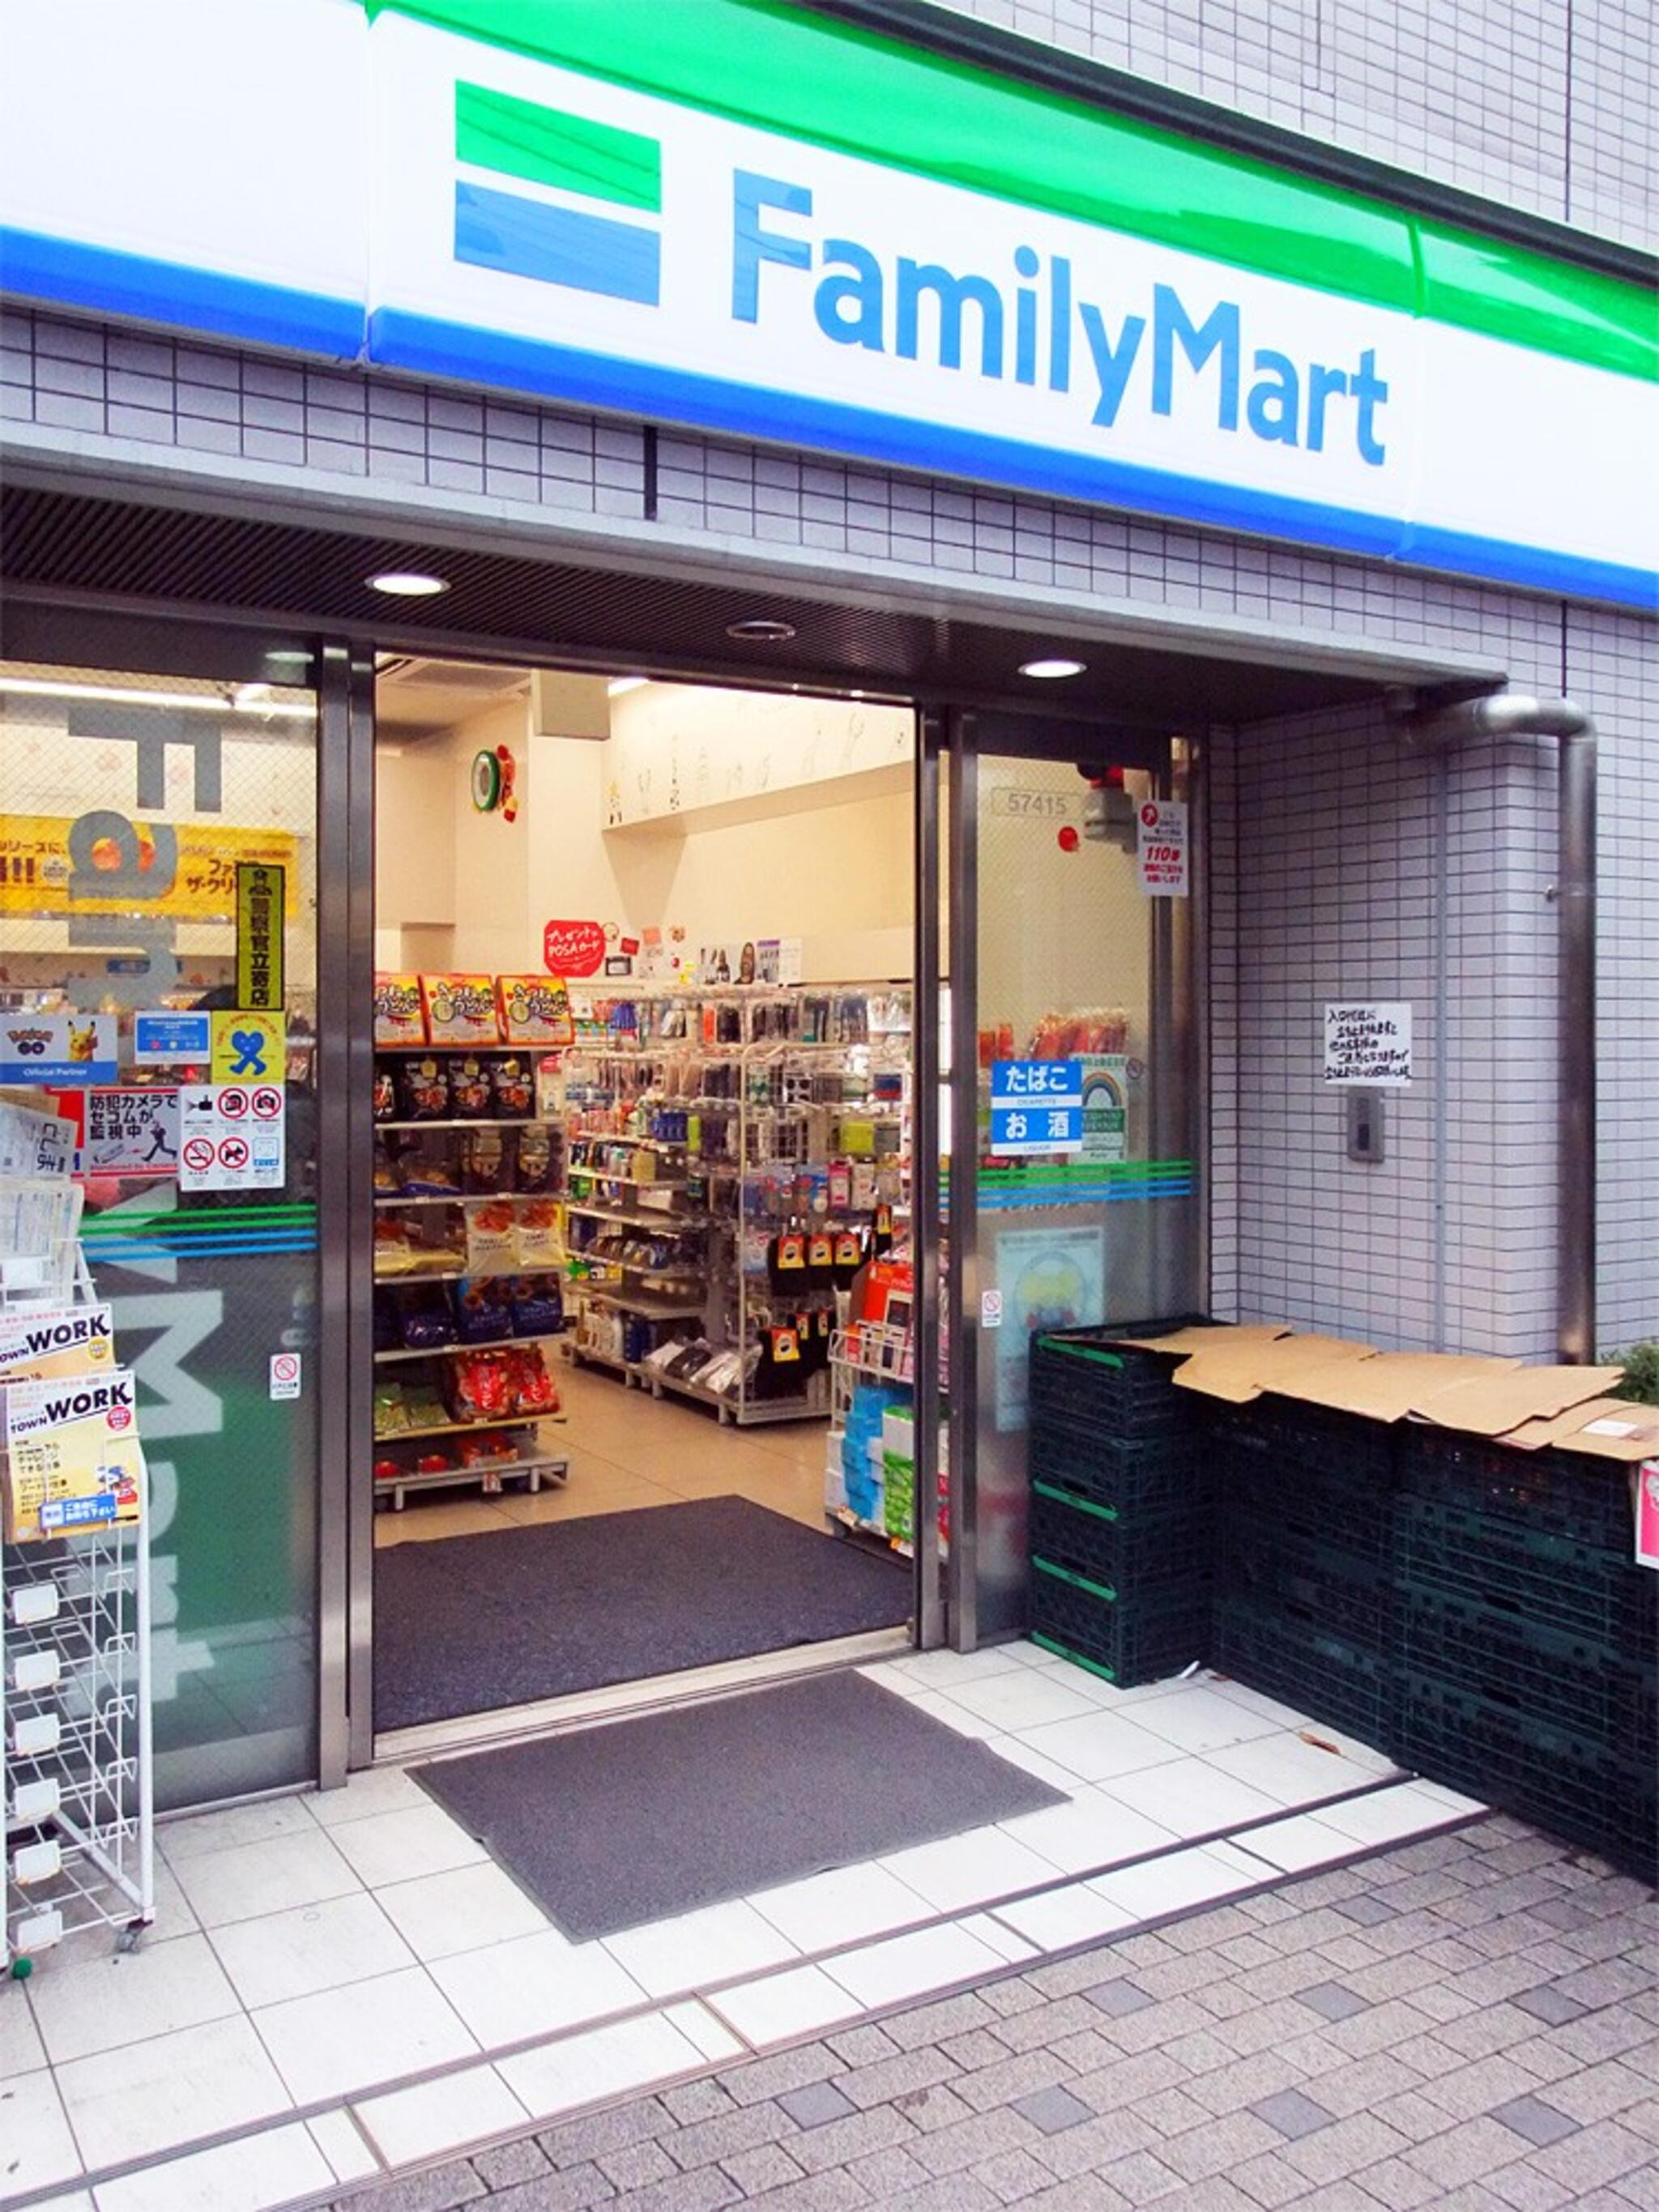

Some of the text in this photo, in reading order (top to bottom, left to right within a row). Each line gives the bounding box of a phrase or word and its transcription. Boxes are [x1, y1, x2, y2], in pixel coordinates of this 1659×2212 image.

[732, 168, 1388, 467] FamilyMart
[1009, 794, 1067, 815] 57415
[1005, 1065, 1068, 1092] たばこ
[90, 1094, 177, 1110] 防犯カメラで
[91, 1108, 153, 1124] セコムが
[1006, 1110, 1069, 1140] お酒
[90, 1123, 142, 1140] 監視中
[0, 1313, 111, 1363] OWN WORK
[11, 1417, 47, 1434] TOWN
[45, 1382, 134, 1422] WORK
